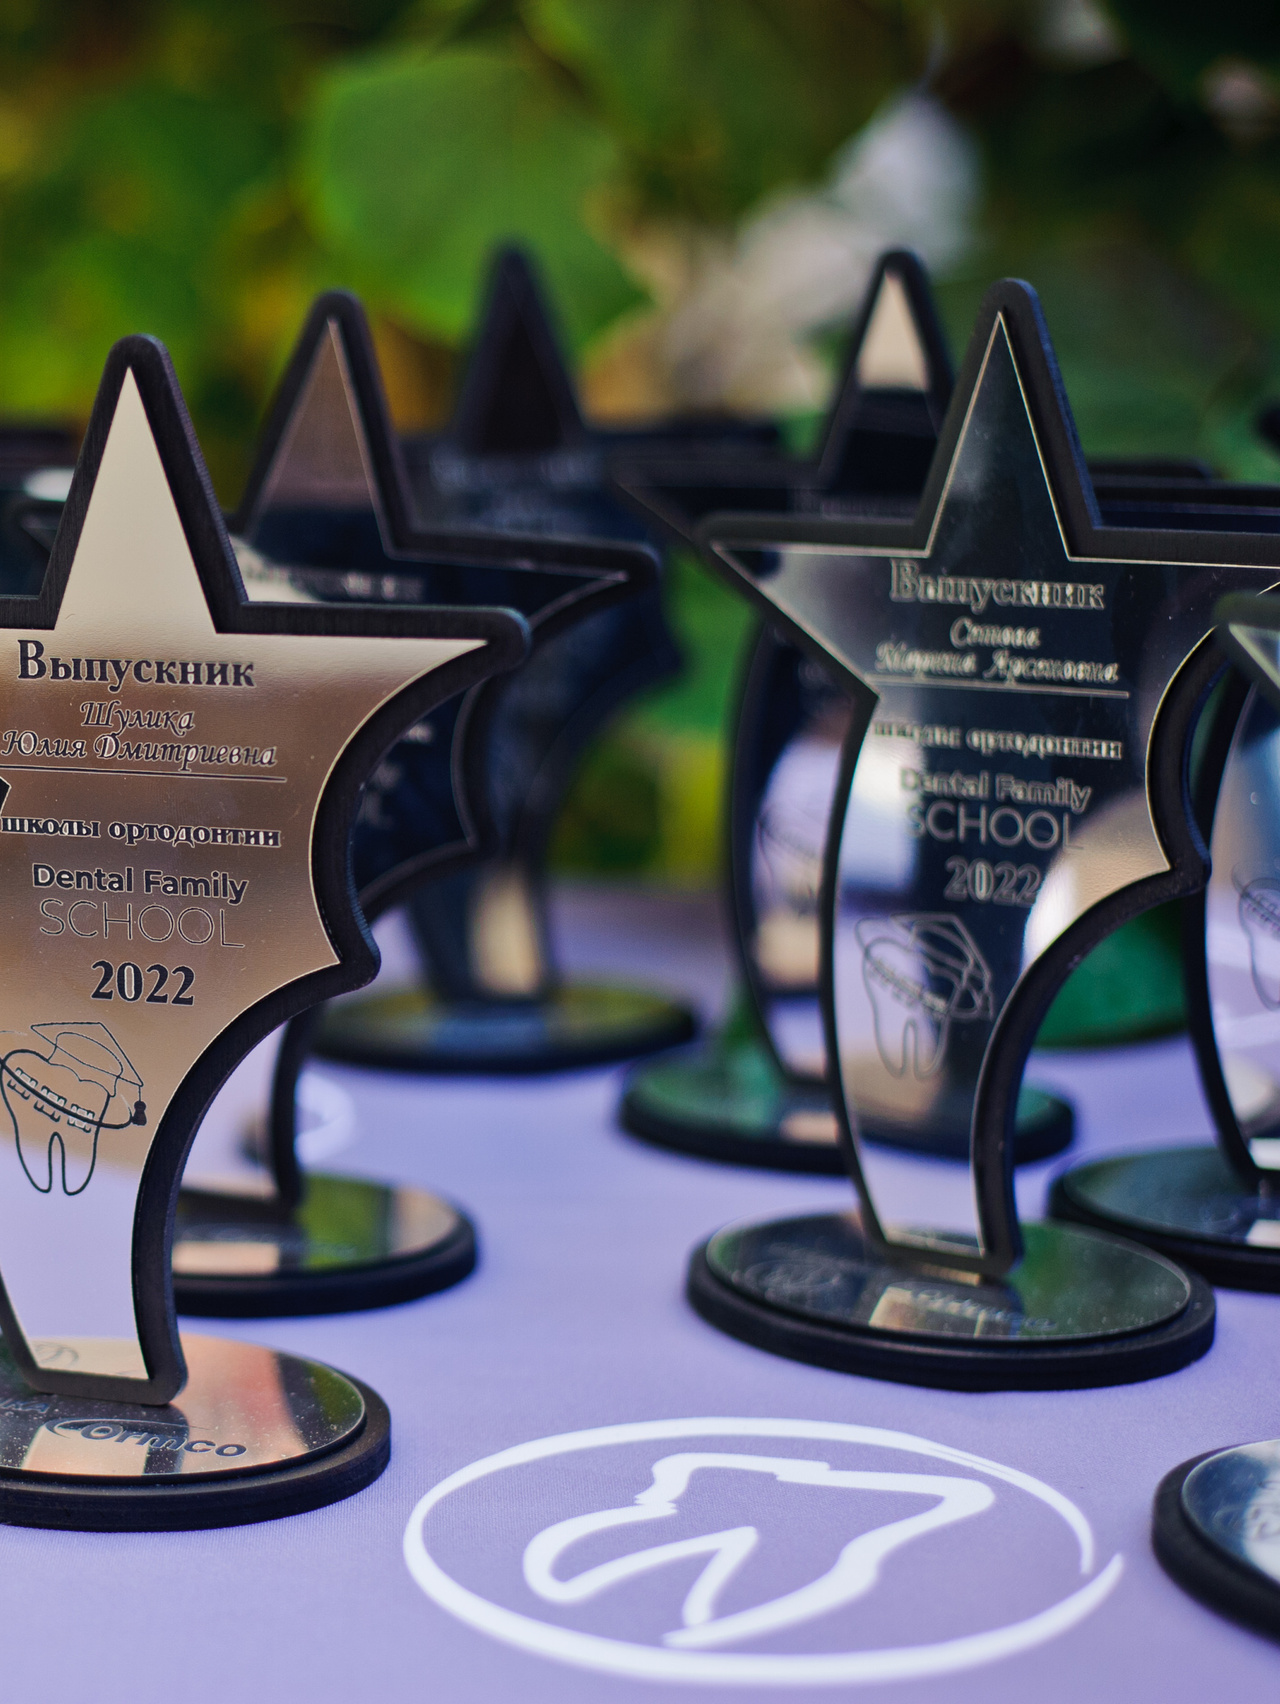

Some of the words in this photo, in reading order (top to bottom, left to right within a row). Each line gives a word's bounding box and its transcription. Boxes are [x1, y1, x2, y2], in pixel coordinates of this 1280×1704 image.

[17, 639, 255, 692] Выпускник
[81, 700, 195, 736] Шулика
[0, 730, 86, 757] Юлия
[93, 734, 277, 772] Дмитриевна
[899, 766, 989, 798] Dental
[994, 772, 1092, 814] Family
[0, 816, 100, 838] школы
[108, 819, 280, 848] ортодонтии
[907, 802, 1083, 850] SCHOOL
[32, 862, 134, 893] Dental
[144, 869, 248, 904] Family
[945, 856, 1043, 902] 2022
[39, 899, 245, 948] SCHOOL
[91, 960, 196, 1006] 2022
